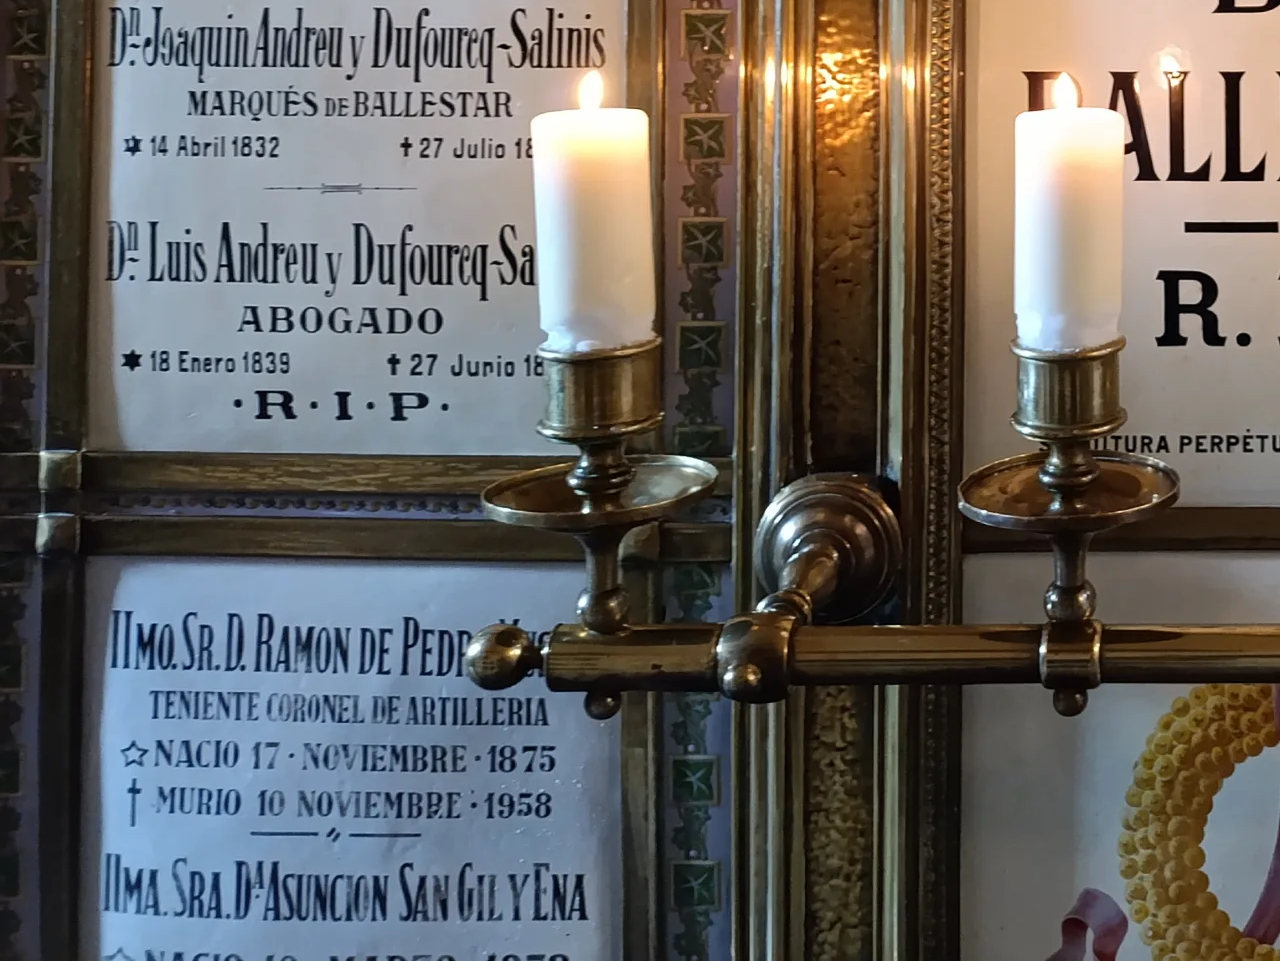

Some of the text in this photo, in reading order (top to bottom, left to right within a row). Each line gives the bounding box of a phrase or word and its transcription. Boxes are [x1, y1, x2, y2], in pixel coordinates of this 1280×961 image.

[251, 8, 343, 67] Andreu
[187, 86, 513, 121] MARQUÉS DE BALLESTAR
[151, 135, 505, 158] 14 Abril 1832 27 Julio
[147, 222, 318, 284] Luis Andreu
[237, 306, 443, 334] ABOGADO
[151, 351, 515, 377] 18 Enero 1839 27 Junio
[358, 628, 393, 675] DE
[150, 691, 549, 726] TENIENTE CORONEL DE ARTILLERIA
[155, 740, 556, 773] NACIO 17 NOVIEMBRE 1875
[157, 787, 552, 819] MURIO 10 NOVIEMBRE 1958
